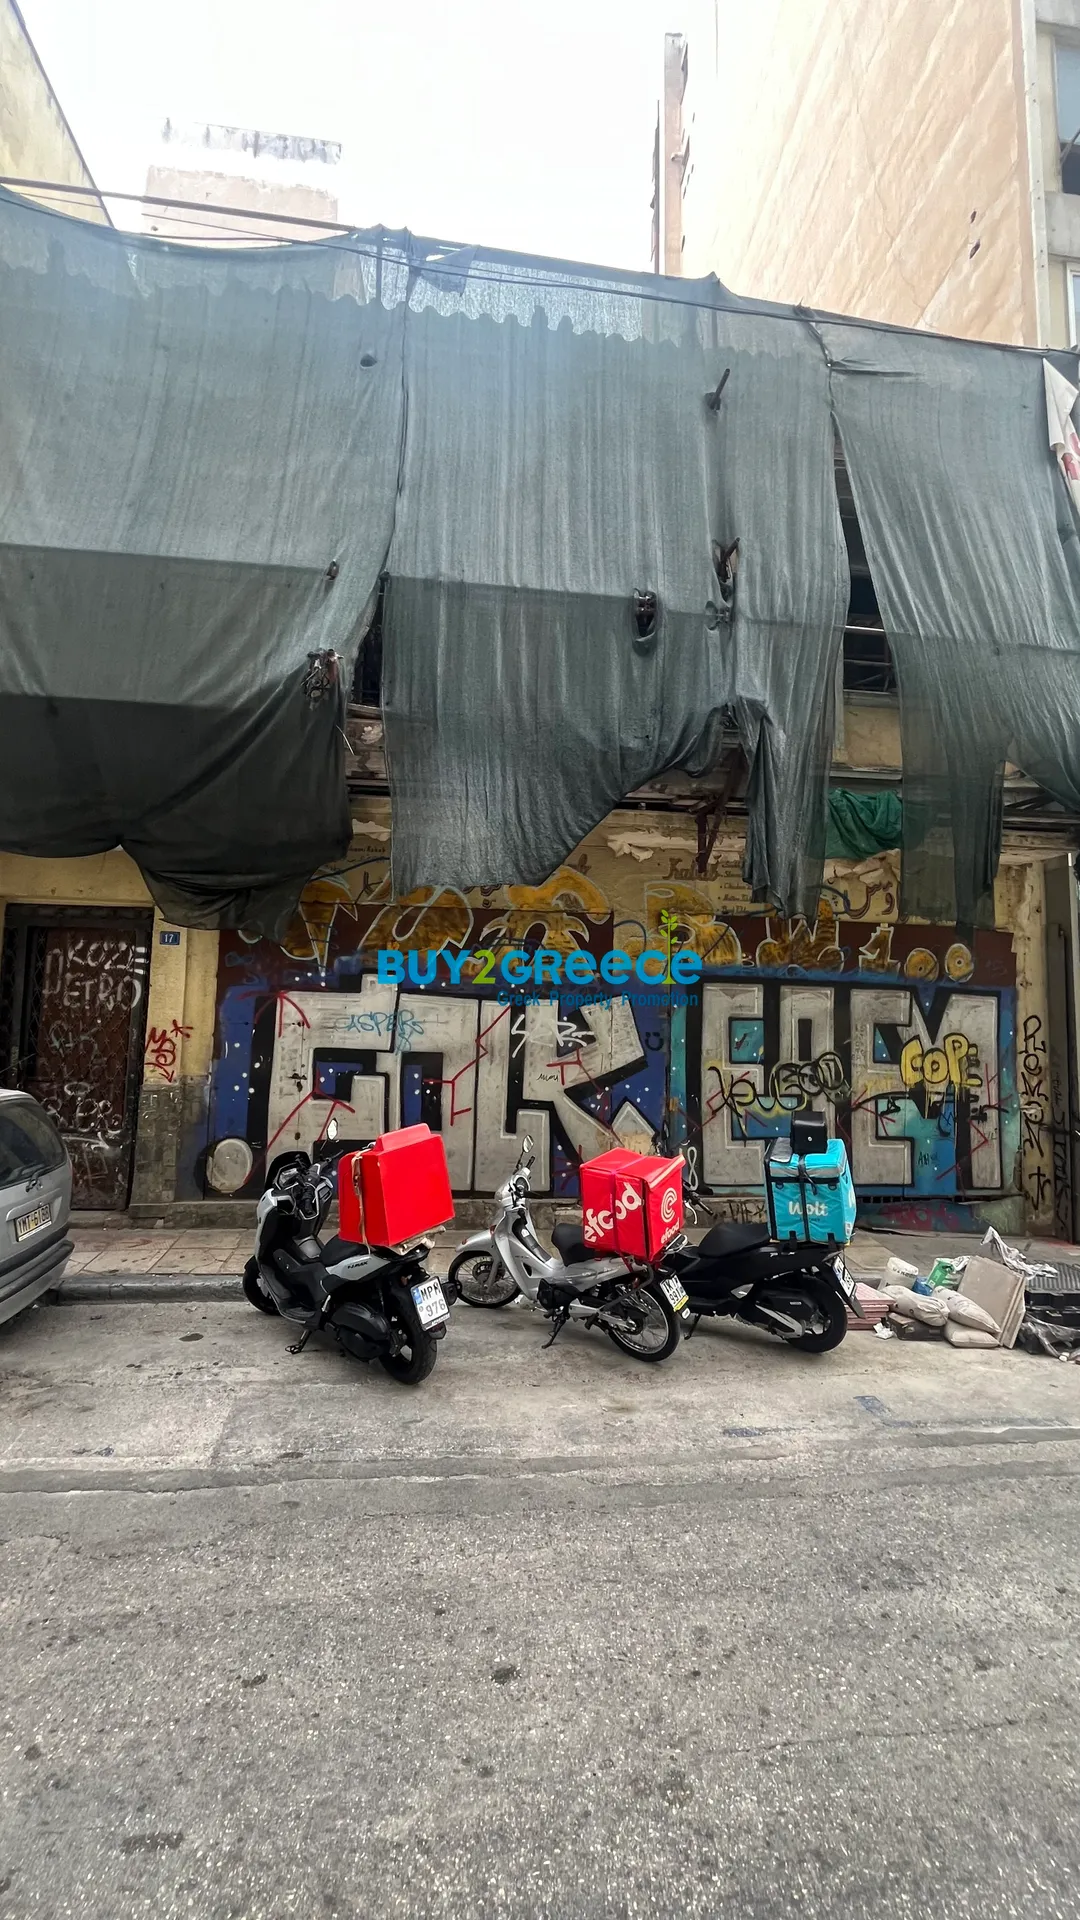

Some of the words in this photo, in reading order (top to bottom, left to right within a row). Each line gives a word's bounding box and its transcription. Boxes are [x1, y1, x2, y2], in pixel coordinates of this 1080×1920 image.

[164, 933, 174, 943] 17
[584, 1181, 645, 1243] efood
[788, 1200, 829, 1217] Wolt
[660, 1216, 680, 1244] efood
[425, 1298, 446, 1317] 976
